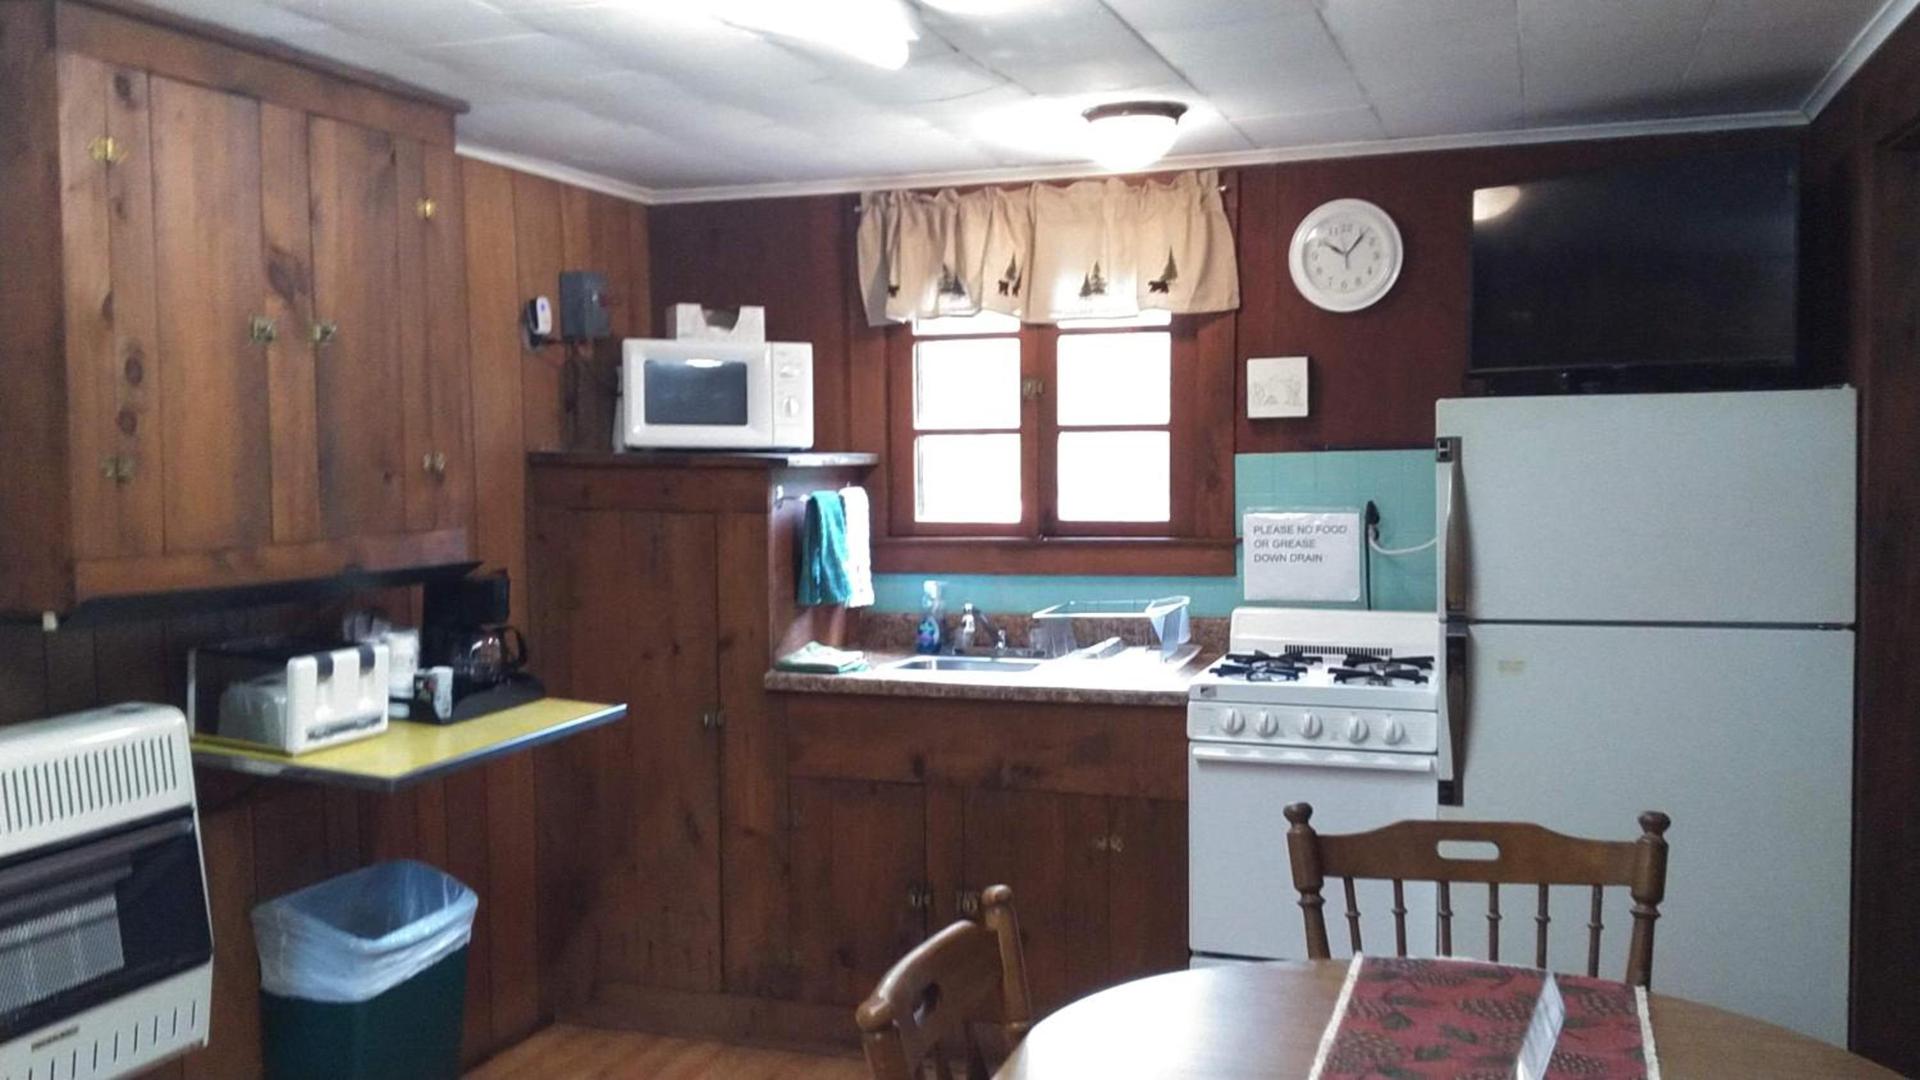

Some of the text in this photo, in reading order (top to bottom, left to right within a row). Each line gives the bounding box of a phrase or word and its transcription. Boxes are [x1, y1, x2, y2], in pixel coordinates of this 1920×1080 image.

[1329, 226, 1338, 236] 11
[1252, 524, 1348, 535] PLEASE NO FOOD
[1253, 538, 1317, 549] OR GREASE
[1253, 552, 1323, 563] DOWN DRAIN
